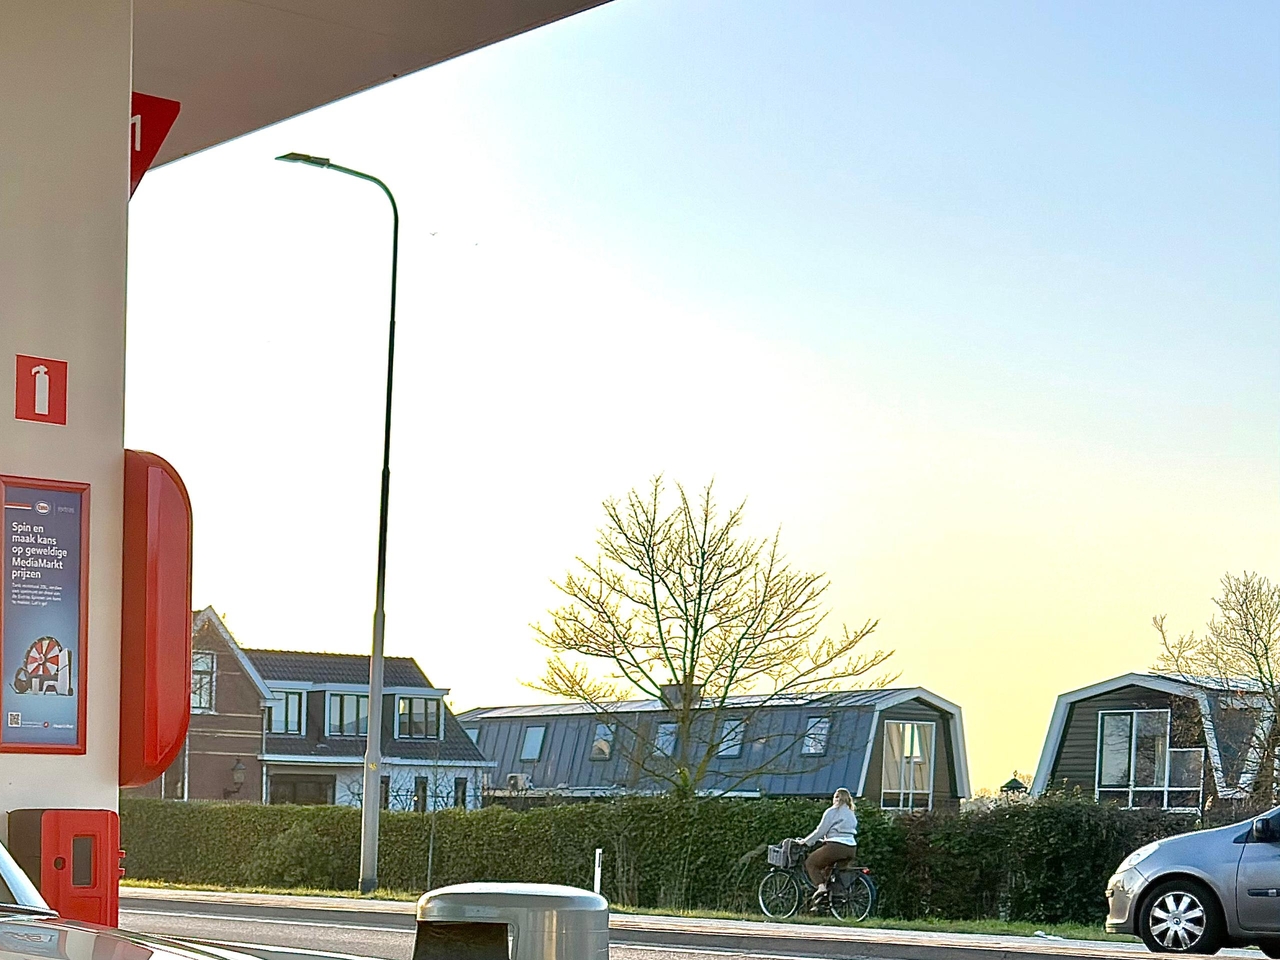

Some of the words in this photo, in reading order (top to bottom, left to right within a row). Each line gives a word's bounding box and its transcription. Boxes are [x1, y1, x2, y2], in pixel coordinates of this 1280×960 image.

[131, 114, 141, 151] 1
[12, 522, 31, 533] Spin
[33, 525, 44, 533] en
[12, 534, 35, 544] maak
[37, 534, 57, 545] kans
[12, 546, 23, 556] op
[26, 546, 67, 559] geweldige
[12, 557, 63, 569] MediaMarkt
[12, 568, 41, 580] prijzen
